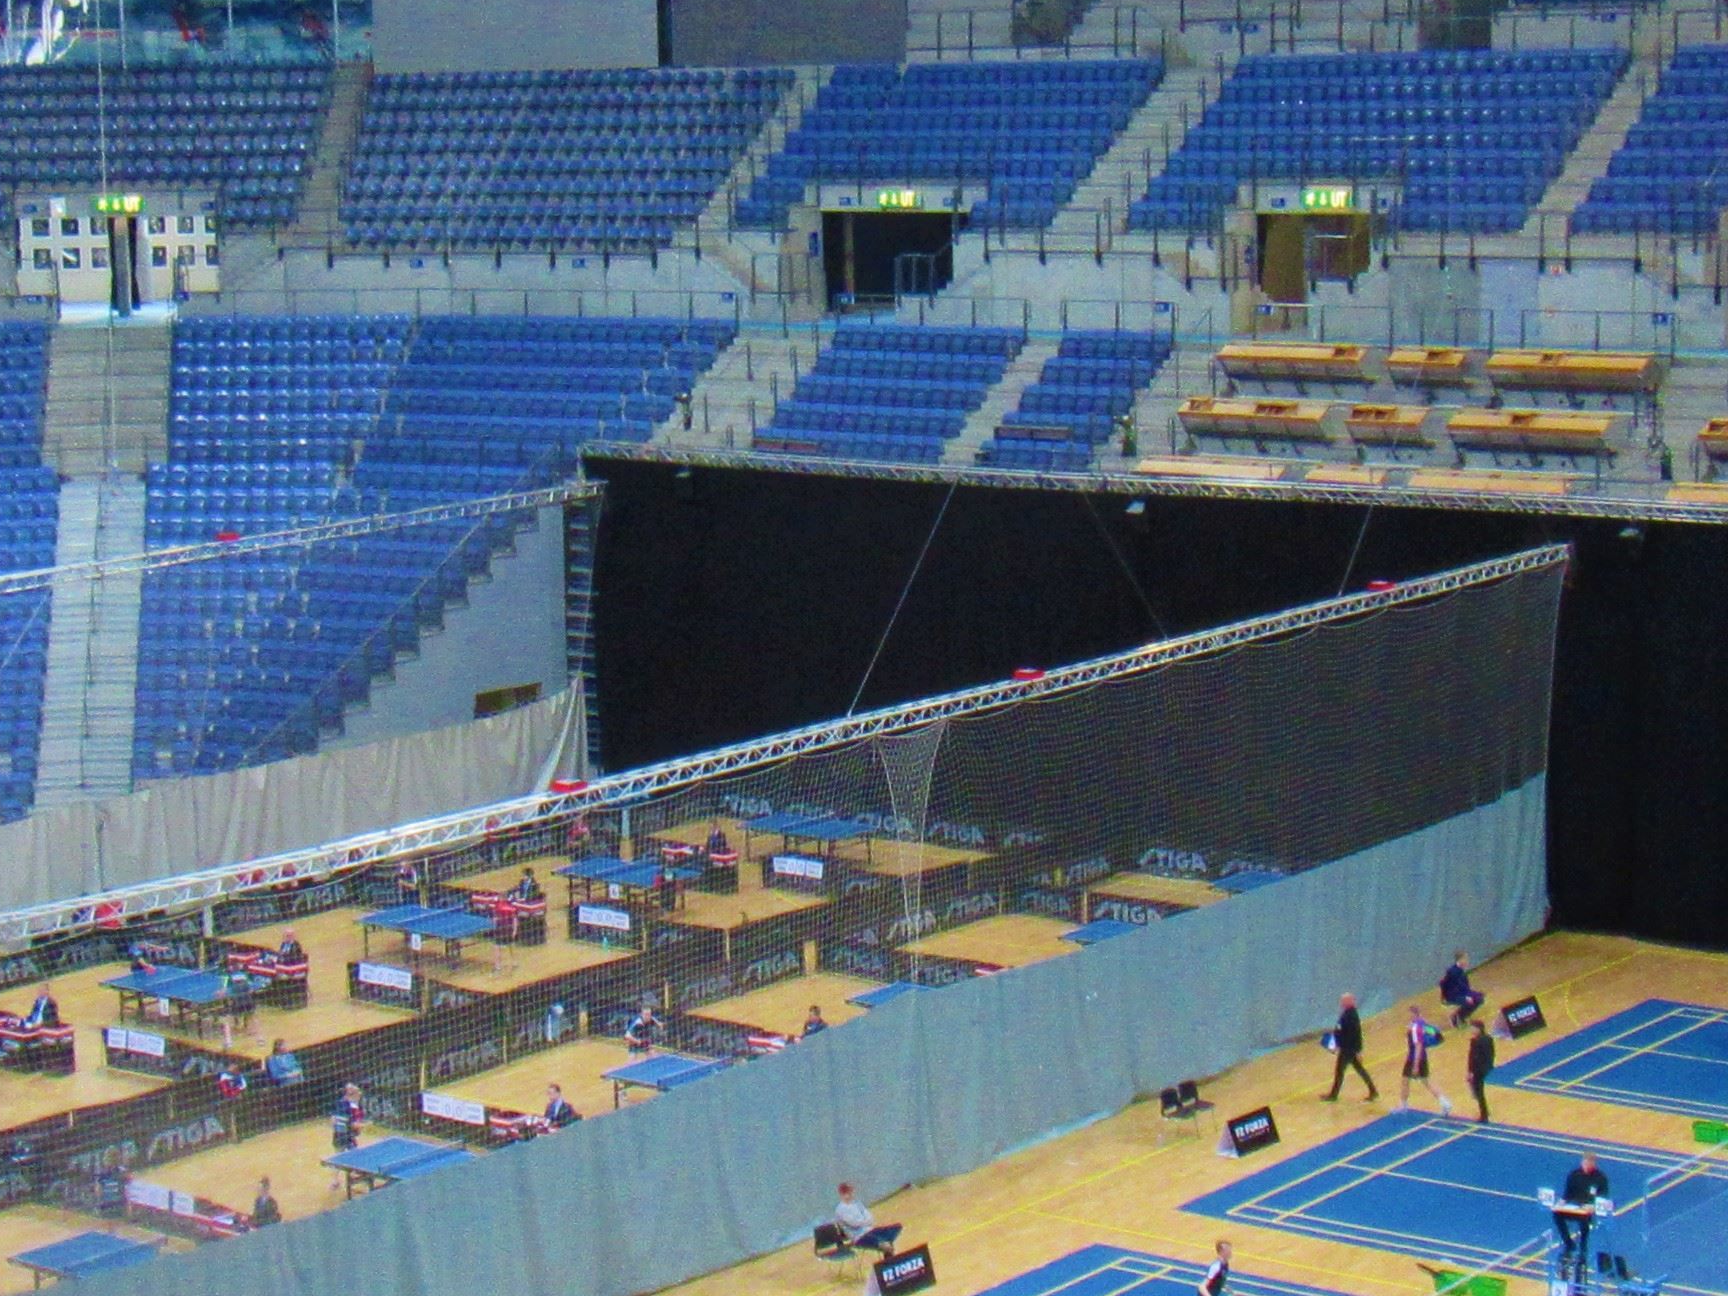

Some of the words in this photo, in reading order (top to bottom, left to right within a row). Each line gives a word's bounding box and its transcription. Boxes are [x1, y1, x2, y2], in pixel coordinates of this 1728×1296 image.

[900, 191, 915, 207] UT
[1331, 191, 1348, 207] UT
[1139, 847, 1208, 872] STIGA
[1093, 901, 1162, 925] STIGA
[149, 1114, 226, 1157] STIGA
[894, 1256, 925, 1277] FORZA
